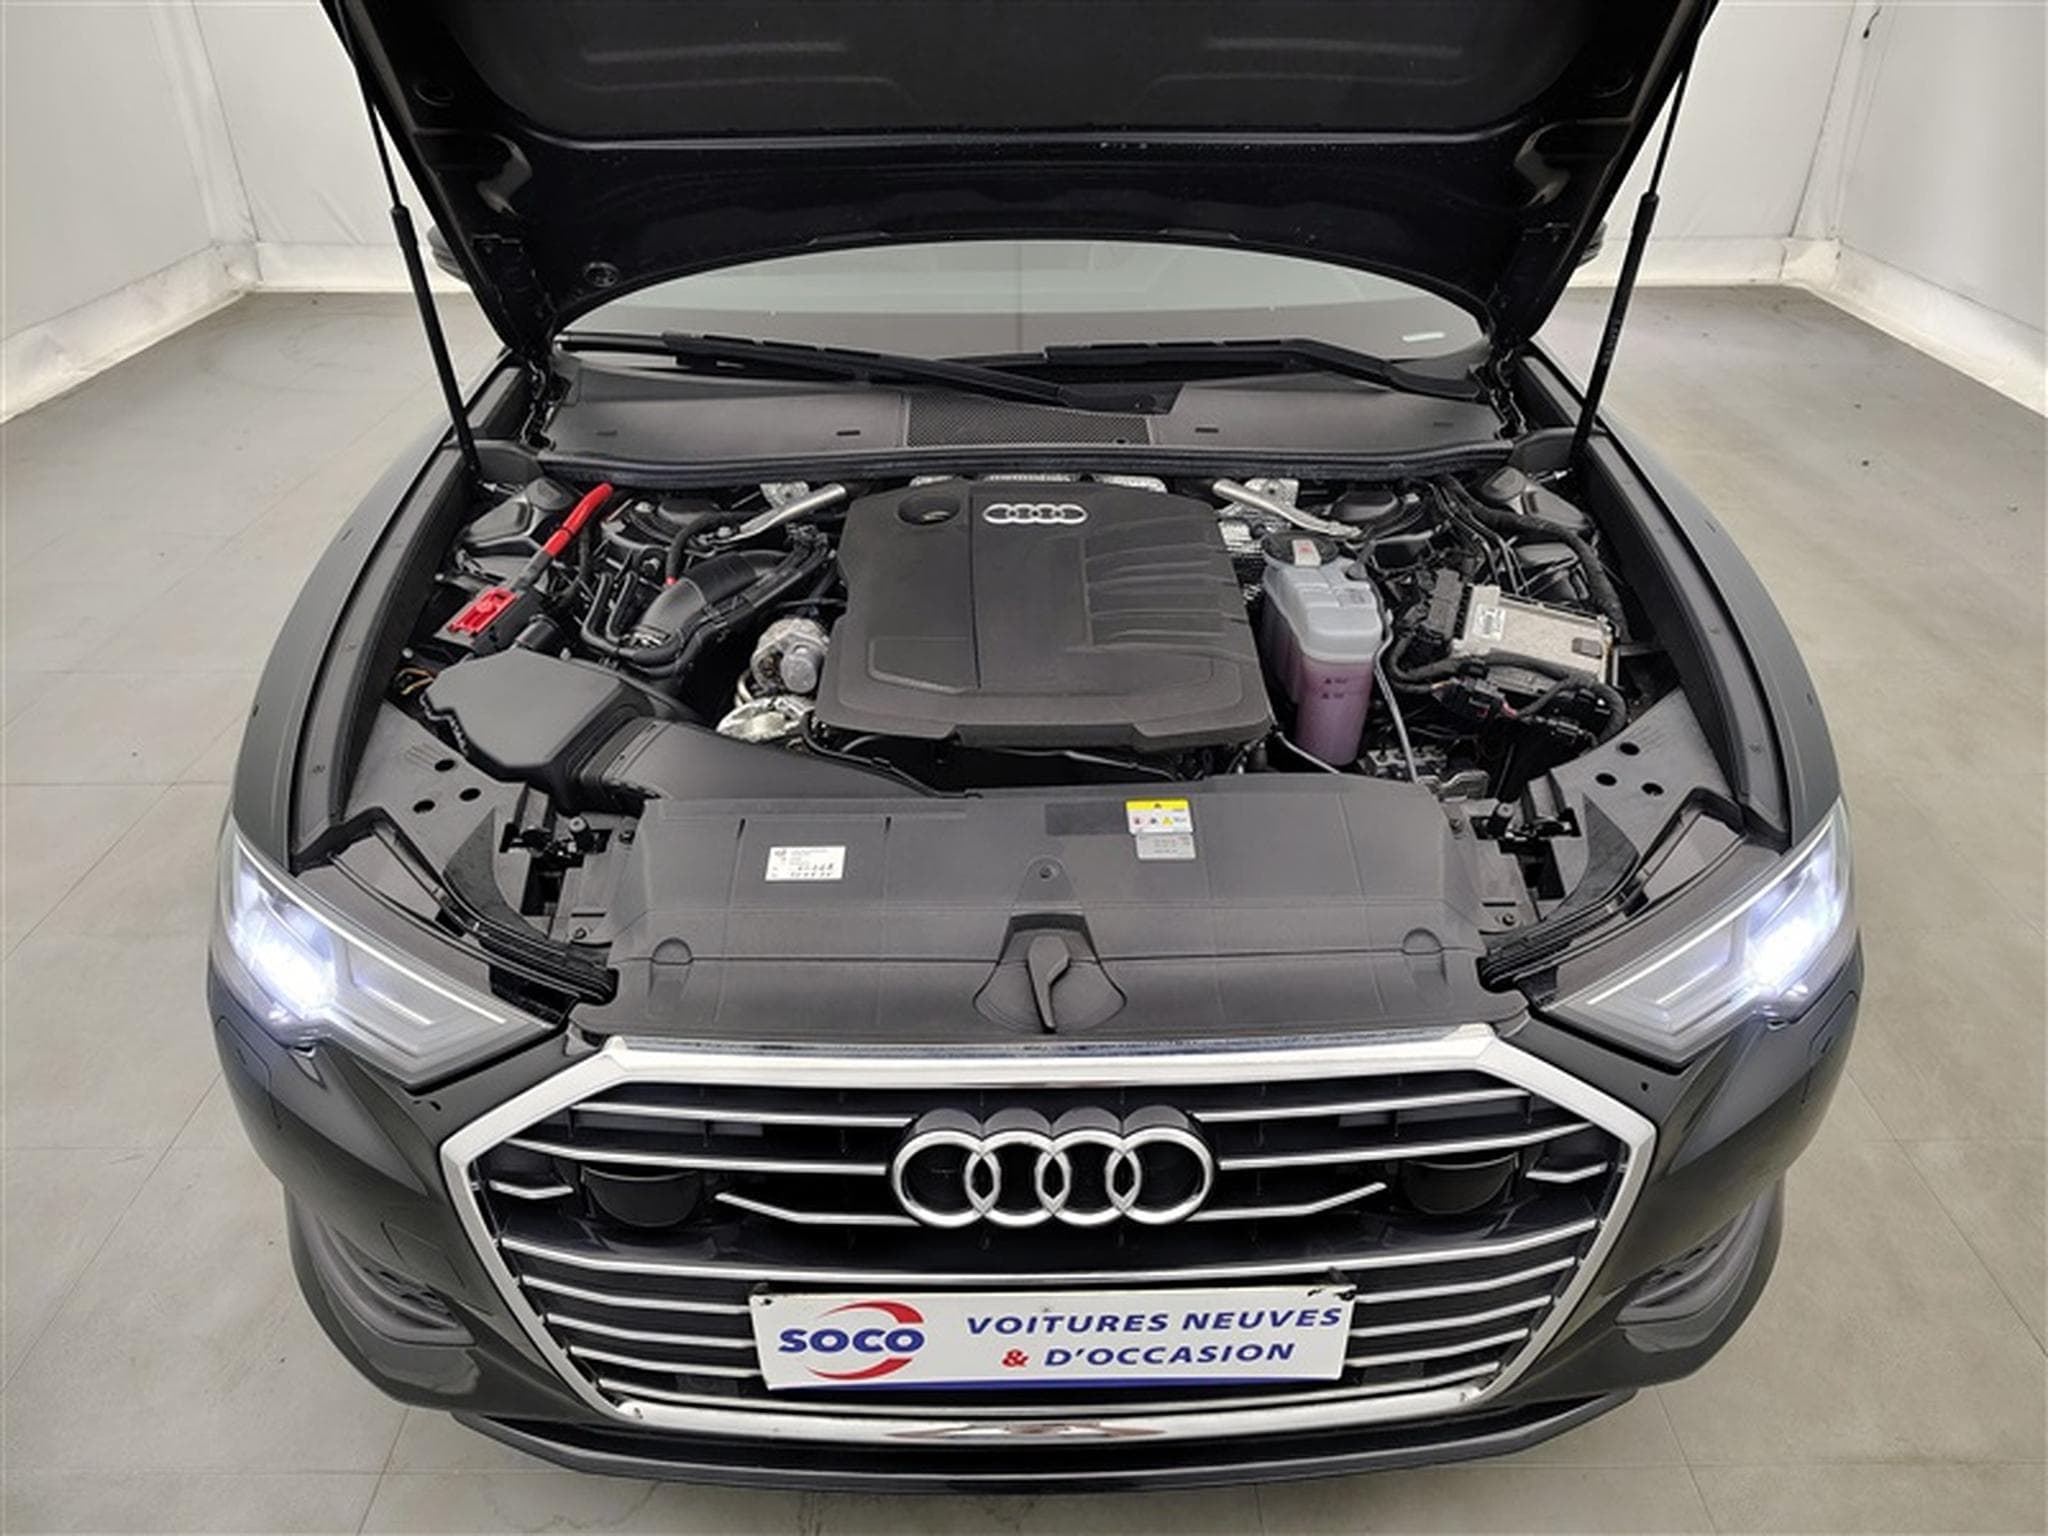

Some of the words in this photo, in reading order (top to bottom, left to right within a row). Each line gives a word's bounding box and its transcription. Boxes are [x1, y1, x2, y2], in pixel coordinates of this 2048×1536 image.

[967, 1314, 1168, 1334] VOITURES
[1182, 1308, 1341, 1331] NEUVES
[779, 1328, 925, 1353] SOCO
[1001, 1349, 1028, 1367] &
[1044, 1343, 1294, 1366] D'OCCASION
